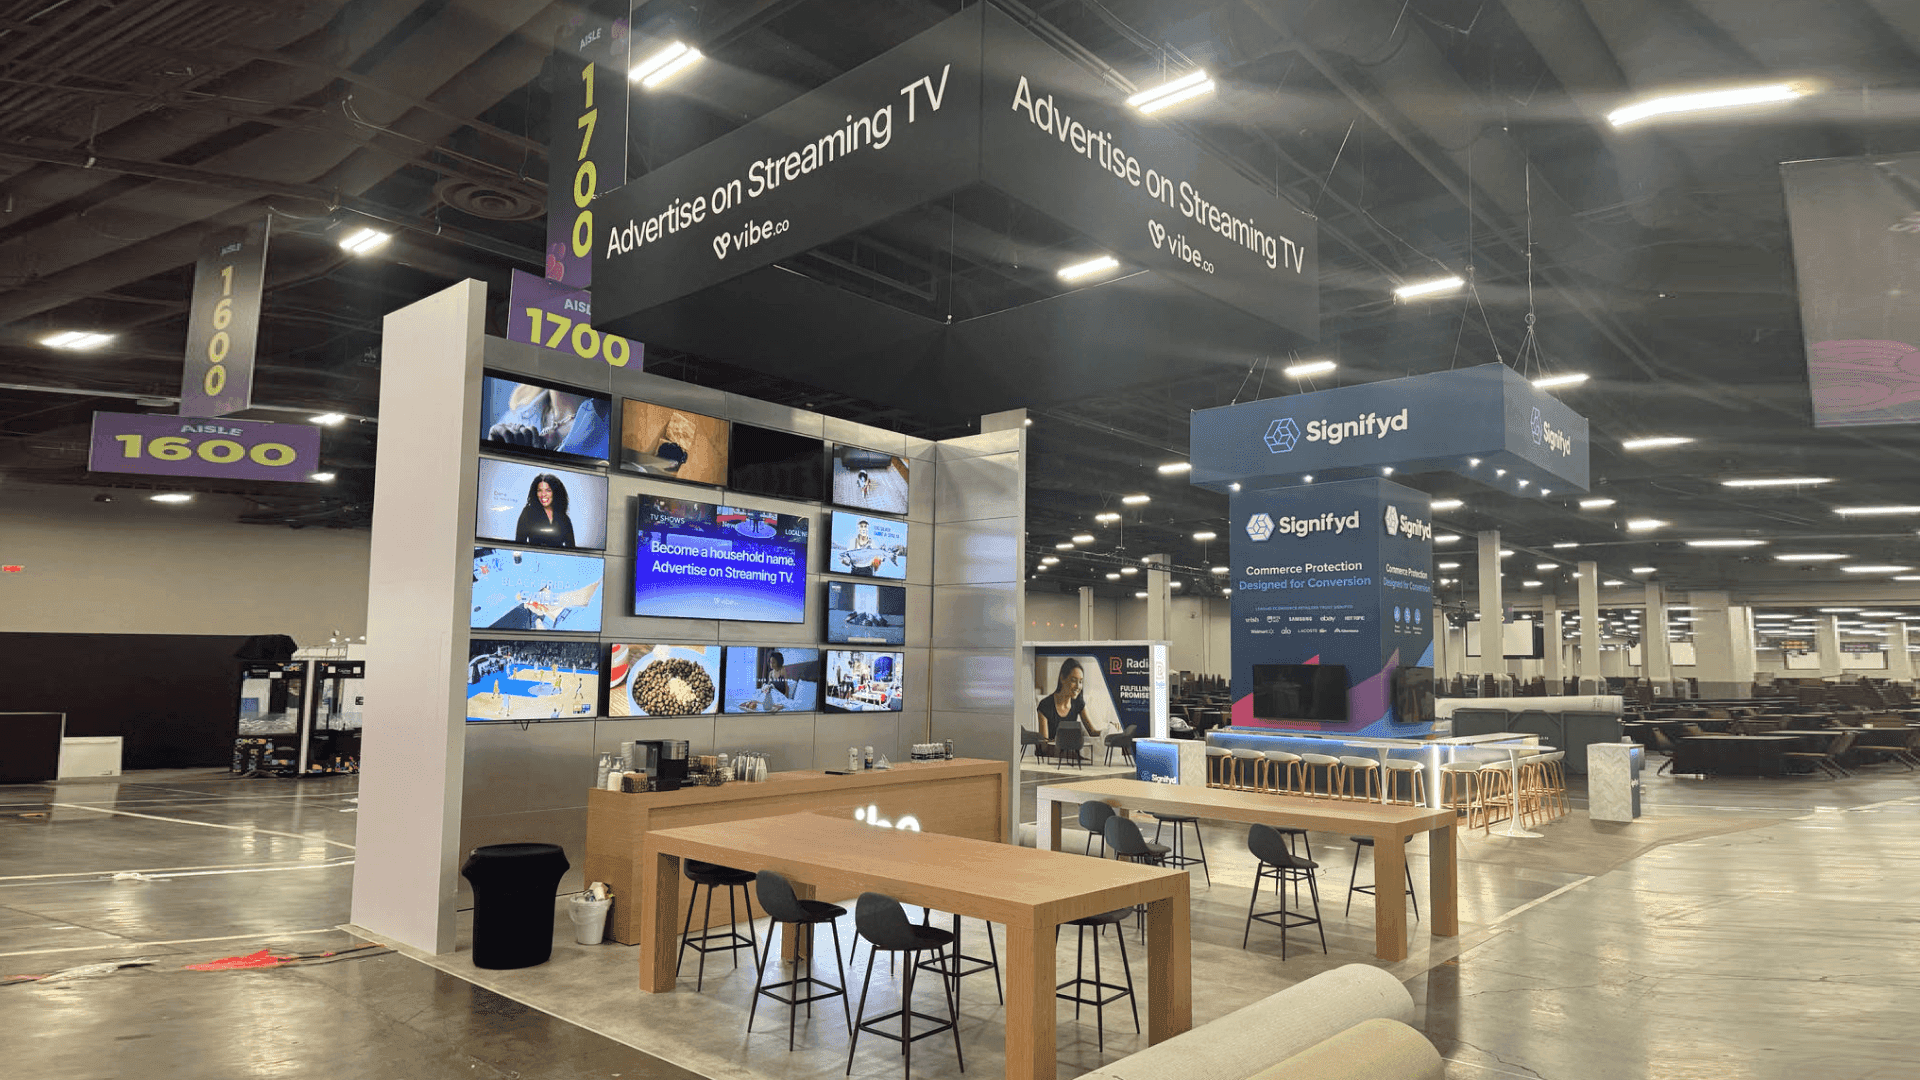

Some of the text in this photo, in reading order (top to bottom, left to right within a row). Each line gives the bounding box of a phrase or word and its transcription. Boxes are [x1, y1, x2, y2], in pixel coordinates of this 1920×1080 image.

[579, 28, 601, 51] AISLE
[572, 62, 597, 258] 1700
[607, 63, 950, 259] Advertise on Streaming TV
[1011, 75, 1304, 274] Advertise on Streaming TV
[733, 219, 790, 251] vibe.co
[1167, 233, 1215, 275] vibe.co
[564, 298, 591, 315] AISL
[204, 264, 234, 396] 1600
[526, 307, 630, 367] 1700
[181, 425, 243, 437] AISLE
[1306, 408, 1408, 445] Signifyd
[1543, 420, 1571, 457] Signifyd
[115, 434, 297, 467] 1600
[650, 513, 685, 524] TV SHOWS
[1279, 510, 1360, 538] Signifyd
[1400, 514, 1432, 541] Signifyd
[651, 541, 699, 557] Become
[701, 548, 708, 557] a
[710, 547, 765, 563] household
[766, 556, 796, 567] name.
[1246, 561, 1363, 576] Commerce Protection
[652, 560, 794, 584] Advertise on Streaming TV.
[1239, 575, 1372, 591] Designed for Conversion
